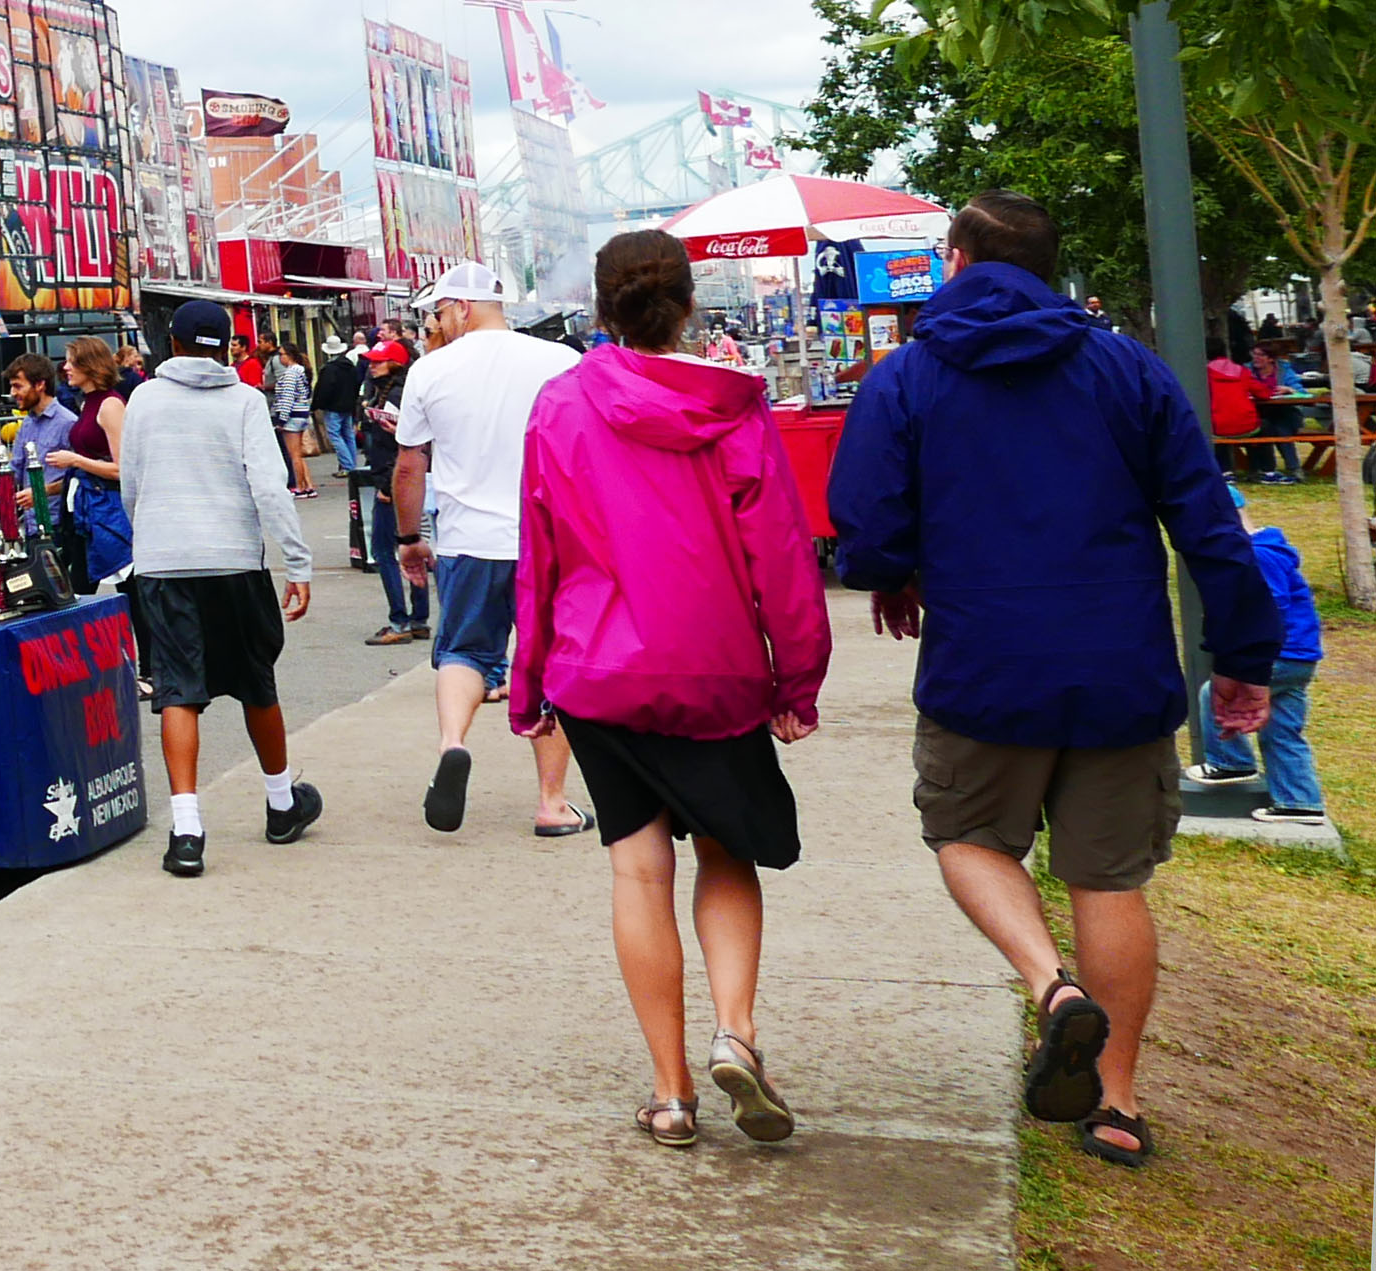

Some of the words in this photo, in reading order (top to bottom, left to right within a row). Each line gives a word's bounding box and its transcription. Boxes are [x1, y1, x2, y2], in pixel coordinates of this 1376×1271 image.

[221, 102, 277, 117] SMOKING
[705, 235, 769, 257] Coca-Cola
[889, 275, 933, 290] GROS
[18, 628, 92, 696] UNCLE
[82, 612, 137, 673] SAM'S
[82, 687, 123, 747] BBQ
[92, 802, 112, 828] NEW
[111, 789, 139, 822] MEXICO
